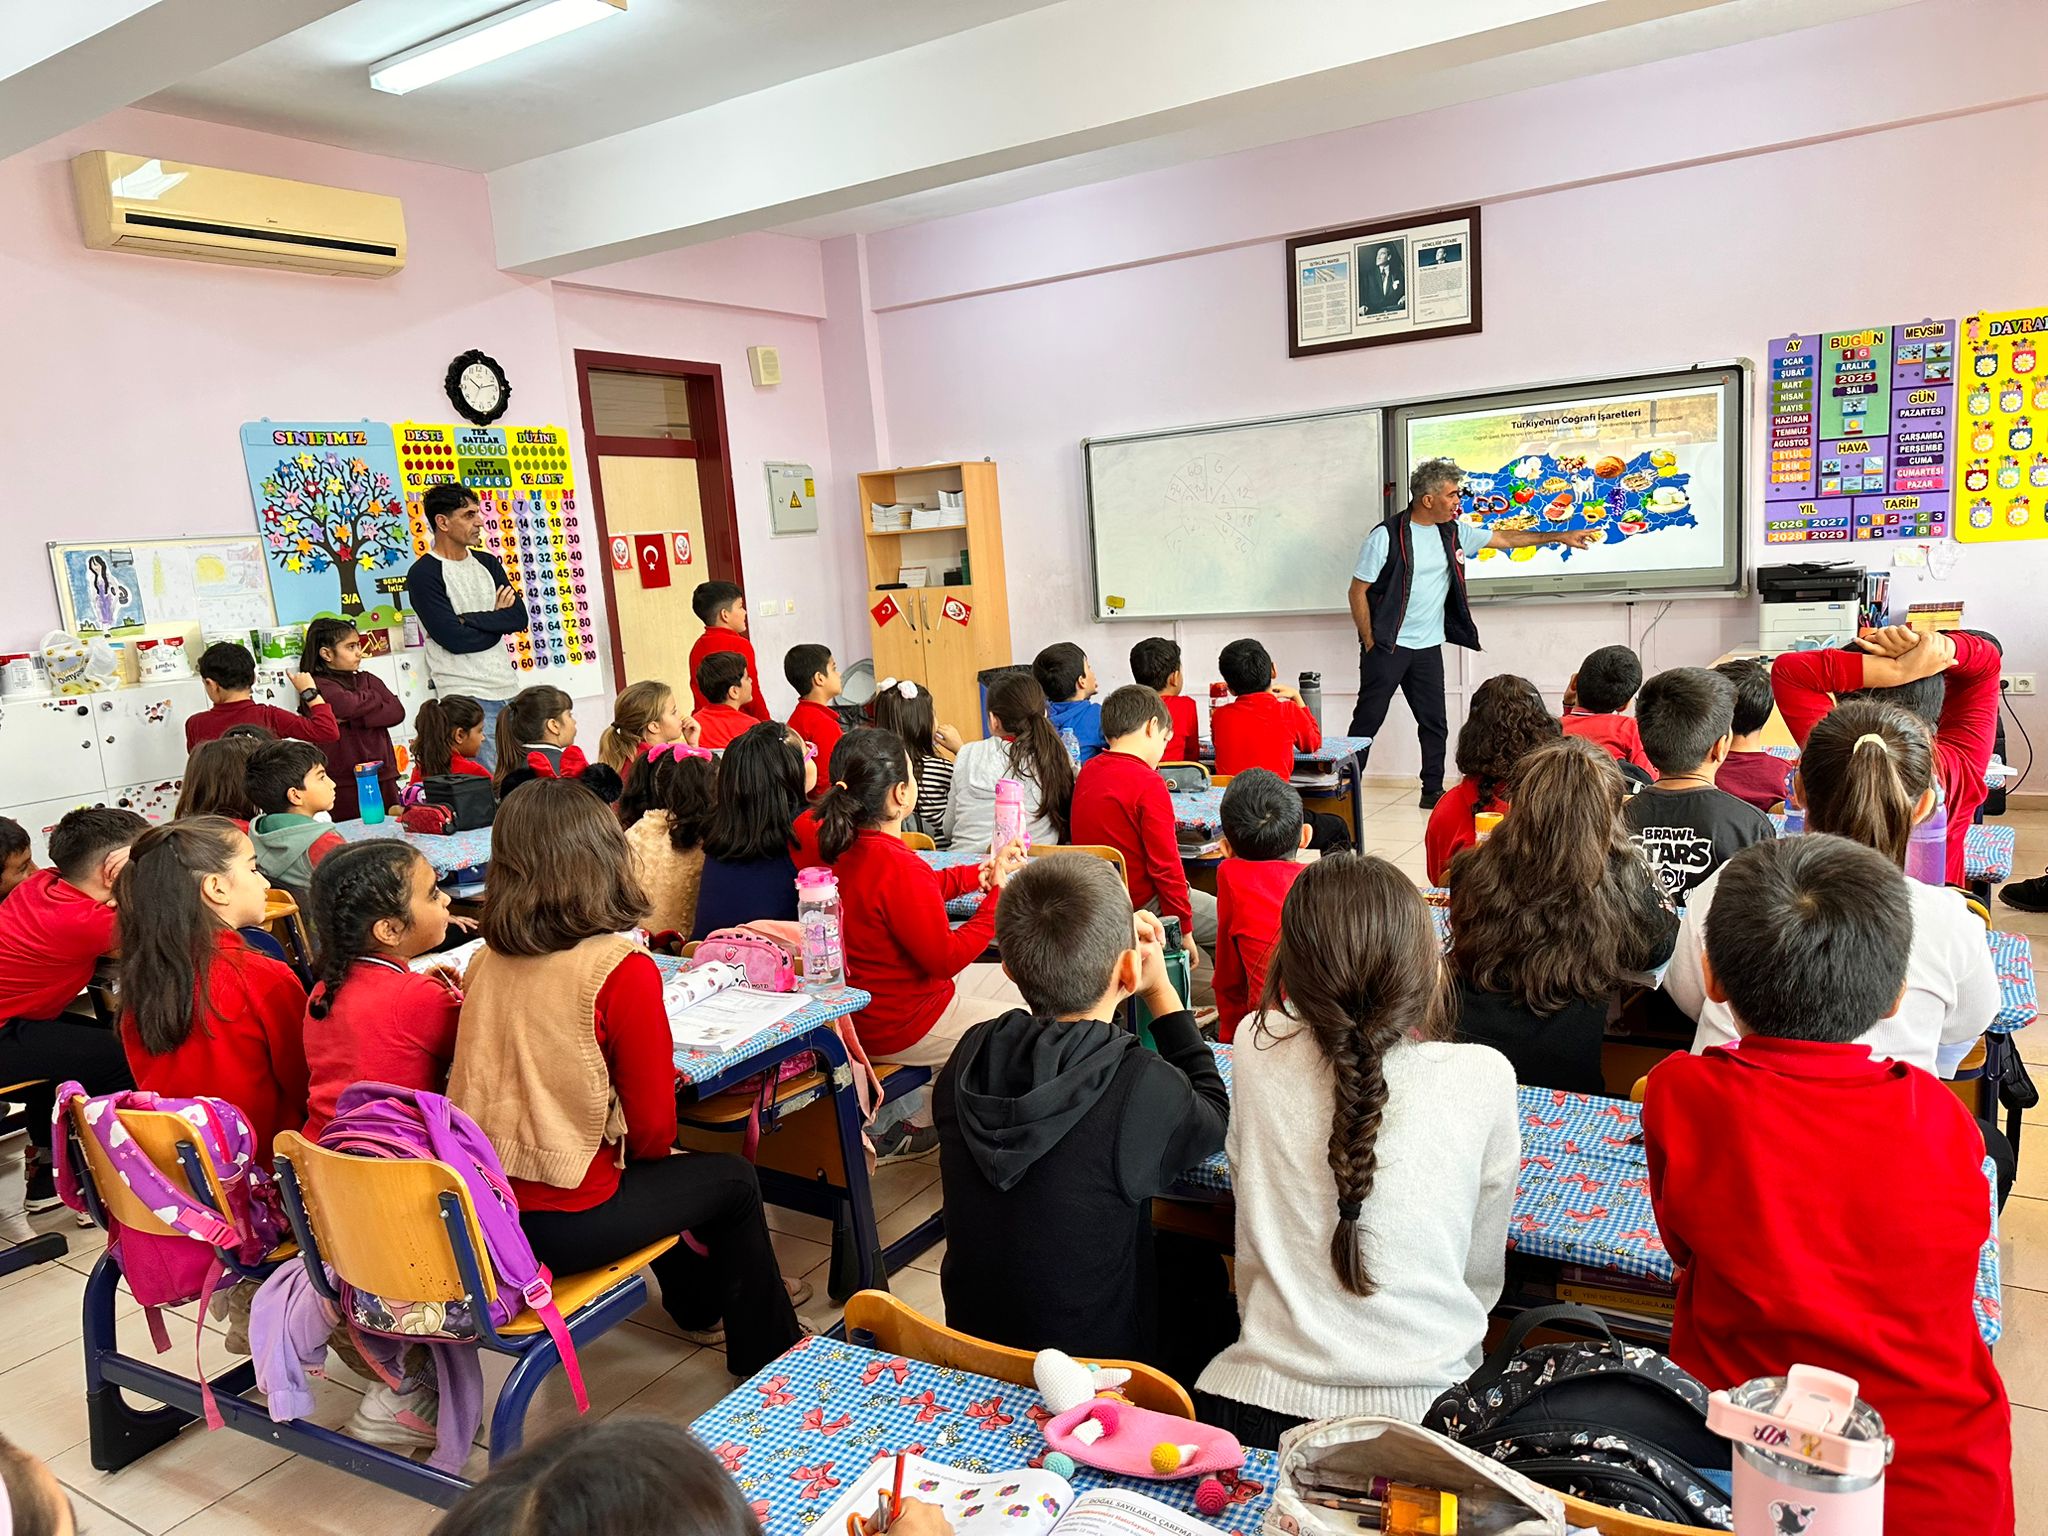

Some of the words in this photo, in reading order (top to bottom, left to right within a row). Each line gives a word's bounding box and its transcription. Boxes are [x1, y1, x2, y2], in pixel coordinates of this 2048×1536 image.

[1906, 324, 1944, 338] MEVSİM
[1830, 331, 1883, 348] BUGÜN
[1786, 341, 1800, 351] AY
[1782, 357, 1804, 366] OCAK
[1840, 362, 1870, 370] ARALIK
[1781, 368, 1806, 378] ŞUBAT
[1839, 374, 1872, 384] 2025
[1782, 381, 1803, 390] MART
[1846, 386, 1864, 394] SALI
[1780, 392, 1804, 401] NİSAN
[1909, 391, 1936, 403] GÜN
[1780, 404, 1804, 412] MAYIS
[1900, 407, 1944, 417] PAZARTESİ
[1562, 414, 1596, 425] Coğrafi
[1776, 415, 1808, 424] HAZİRAN
[406, 429, 444, 442] DESTE
[518, 430, 558, 444] DÜZİNE
[1776, 427, 1808, 436] TEMMUZ
[1900, 432, 1944, 442] ÇARŞAMBA
[274, 430, 368, 446] SINIFIMIZ
[470, 445, 476, 454] 3
[480, 445, 486, 454] 5
[490, 445, 496, 454] 7
[500, 445, 506, 454] 9
[1838, 442, 1868, 452] HAVA
[1900, 444, 1942, 454] PERŞEMBE
[475, 459, 495, 468] ÇİFT
[1909, 456, 1932, 464] CUMA
[468, 468, 505, 476] SAYILAR
[1780, 472, 1803, 482] KASIM
[1897, 466, 1944, 477] CUMARTESİ
[408, 473, 422, 486] 10
[424, 474, 455, 486] ADET
[464, 478, 470, 486] 0
[475, 478, 480, 486] 2
[484, 478, 491, 486] 4
[495, 478, 500, 486] 6
[505, 477, 510, 486] 8
[522, 473, 534, 484] 12
[536, 473, 564, 485] ADET
[1907, 480, 1933, 488] PAZAR
[412, 504, 418, 514] 1
[485, 502, 492, 512] 5
[502, 502, 508, 512] 6
[518, 501, 524, 510] 7
[534, 501, 540, 510] 8
[550, 500, 556, 510] 9
[564, 500, 575, 510] 10
[1884, 496, 1918, 508] TARİH
[1800, 504, 1816, 514] YIL
[1772, 520, 1804, 529] 2026
[1812, 518, 1844, 528] 2027
[1860, 516, 1868, 524] 0
[1920, 513, 1928, 521] 2
[1934, 512, 1942, 520] 3
[416, 522, 422, 532] 2
[486, 520, 498, 530] 10
[502, 520, 514, 528] 12
[519, 519, 528, 528] 14
[534, 518, 546, 528] 16
[550, 518, 561, 528] 18
[566, 518, 578, 526] 20
[1772, 532, 1802, 541] 2028
[1812, 530, 1844, 540] 2029
[1874, 529, 1882, 537] 5
[1904, 526, 1913, 535] 7
[1919, 526, 1926, 534] 8
[1934, 525, 1942, 534] 9
[418, 541, 425, 551] 3
[489, 538, 500, 548] 15
[504, 537, 516, 546] 18
[522, 536, 531, 546] 21
[536, 536, 548, 546] 24
[552, 535, 564, 544] 27
[568, 534, 580, 544] 30
[506, 554, 518, 564] 24
[524, 554, 534, 563] 28
[539, 553, 551, 562] 32
[554, 552, 567, 561] 36
[570, 551, 582, 560] 40
[382, 576, 407, 584] SERAP
[509, 572, 520, 582] 30
[526, 571, 536, 580] 35
[541, 570, 554, 580] 40
[557, 569, 570, 578] 45
[573, 568, 584, 577] 50
[528, 588, 538, 598] 42
[544, 587, 556, 596] 48
[560, 586, 572, 595] 54
[576, 584, 586, 594] 60
[342, 593, 360, 604] 3/A
[530, 605, 541, 614] 49
[546, 604, 558, 614] 56
[562, 602, 574, 612] 63
[578, 602, 588, 610] 70
[532, 622, 544, 632] 56
[548, 621, 560, 630] 64
[564, 619, 577, 628] 72
[580, 618, 590, 627] 80
[518, 641, 530, 651] 54
[534, 640, 546, 648] 63
[550, 638, 563, 648] 72
[568, 635, 580, 645] 81
[582, 634, 593, 644] 90
[522, 658, 534, 668] 60
[536, 656, 548, 666] 70
[554, 654, 566, 664] 80
[570, 652, 582, 662] 90
[584, 650, 596, 660] 100
[1644, 828, 1695, 841] BRAWL
[1116, 1501, 1157, 1522] SAYILARLA
[1158, 1518, 1192, 1536] ÇARPMA
